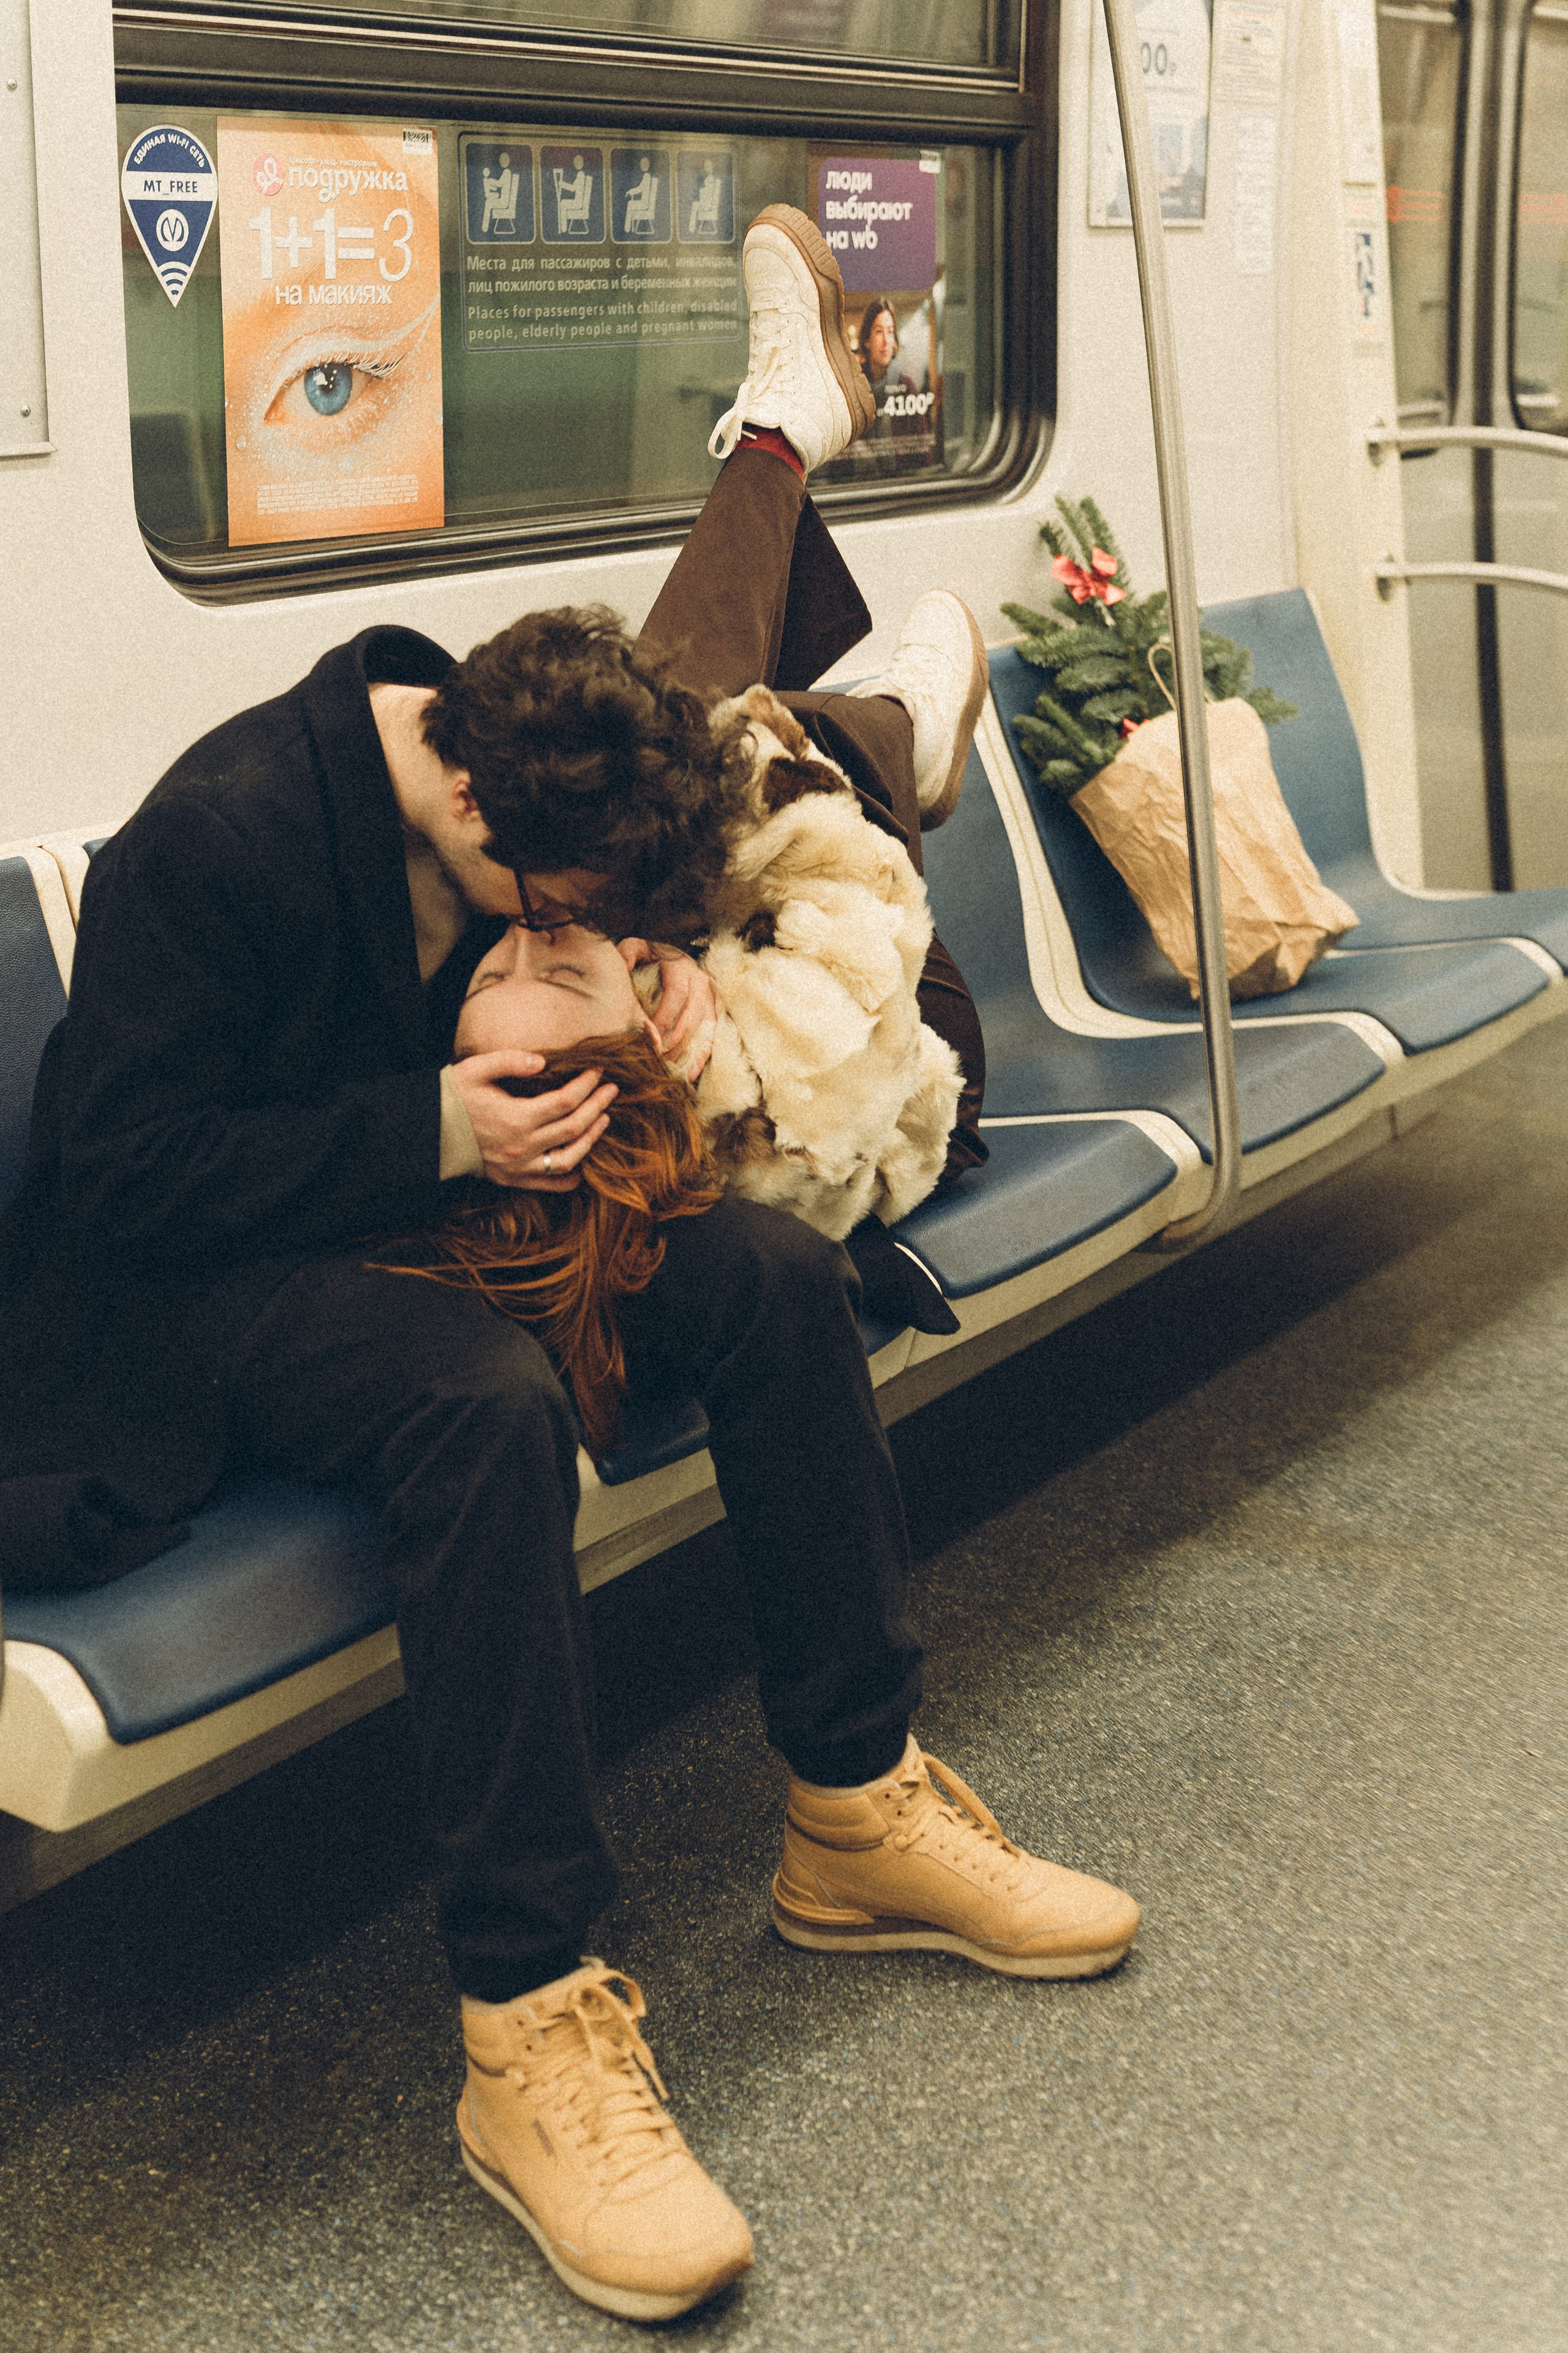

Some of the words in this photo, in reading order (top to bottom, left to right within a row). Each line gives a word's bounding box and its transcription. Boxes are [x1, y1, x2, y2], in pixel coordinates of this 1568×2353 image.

[134, 133, 166, 165] ЕДИНАЯ
[167, 132, 190, 149] WI-FI
[189, 145, 205, 168] СЕТЬ
[143, 179, 198, 195] MT_FREE
[288, 167, 409, 203] подружка
[826, 171, 873, 194] люди
[826, 194, 914, 227] выбирают
[248, 206, 415, 282] 1+1=3
[826, 230, 850, 250] на
[851, 224, 878, 250] wb
[467, 255, 507, 271] Места
[511, 258, 535, 272] для
[540, 257, 611, 272] пассажиров
[616, 257, 622, 268] с
[275, 284, 303, 306] на
[308, 284, 393, 306] макияж
[467, 281, 493, 295] лиц
[495, 279, 556, 293] пожилого
[557, 279, 609, 294] возраста
[611, 279, 619, 290] и
[620, 274, 692, 293] беременных
[692, 276, 737, 289] женщин
[468, 305, 510, 320] Places
[512, 304, 532, 318] for
[535, 305, 604, 321] passengers
[608, 301, 635, 315] with
[690, 298, 737, 312] disabled
[469, 325, 518, 344] people,
[522, 322, 567, 340] elderly
[571, 320, 612, 338] people
[615, 320, 638, 334] and
[641, 319, 695, 336] pregnant
[697, 319, 737, 331] women
